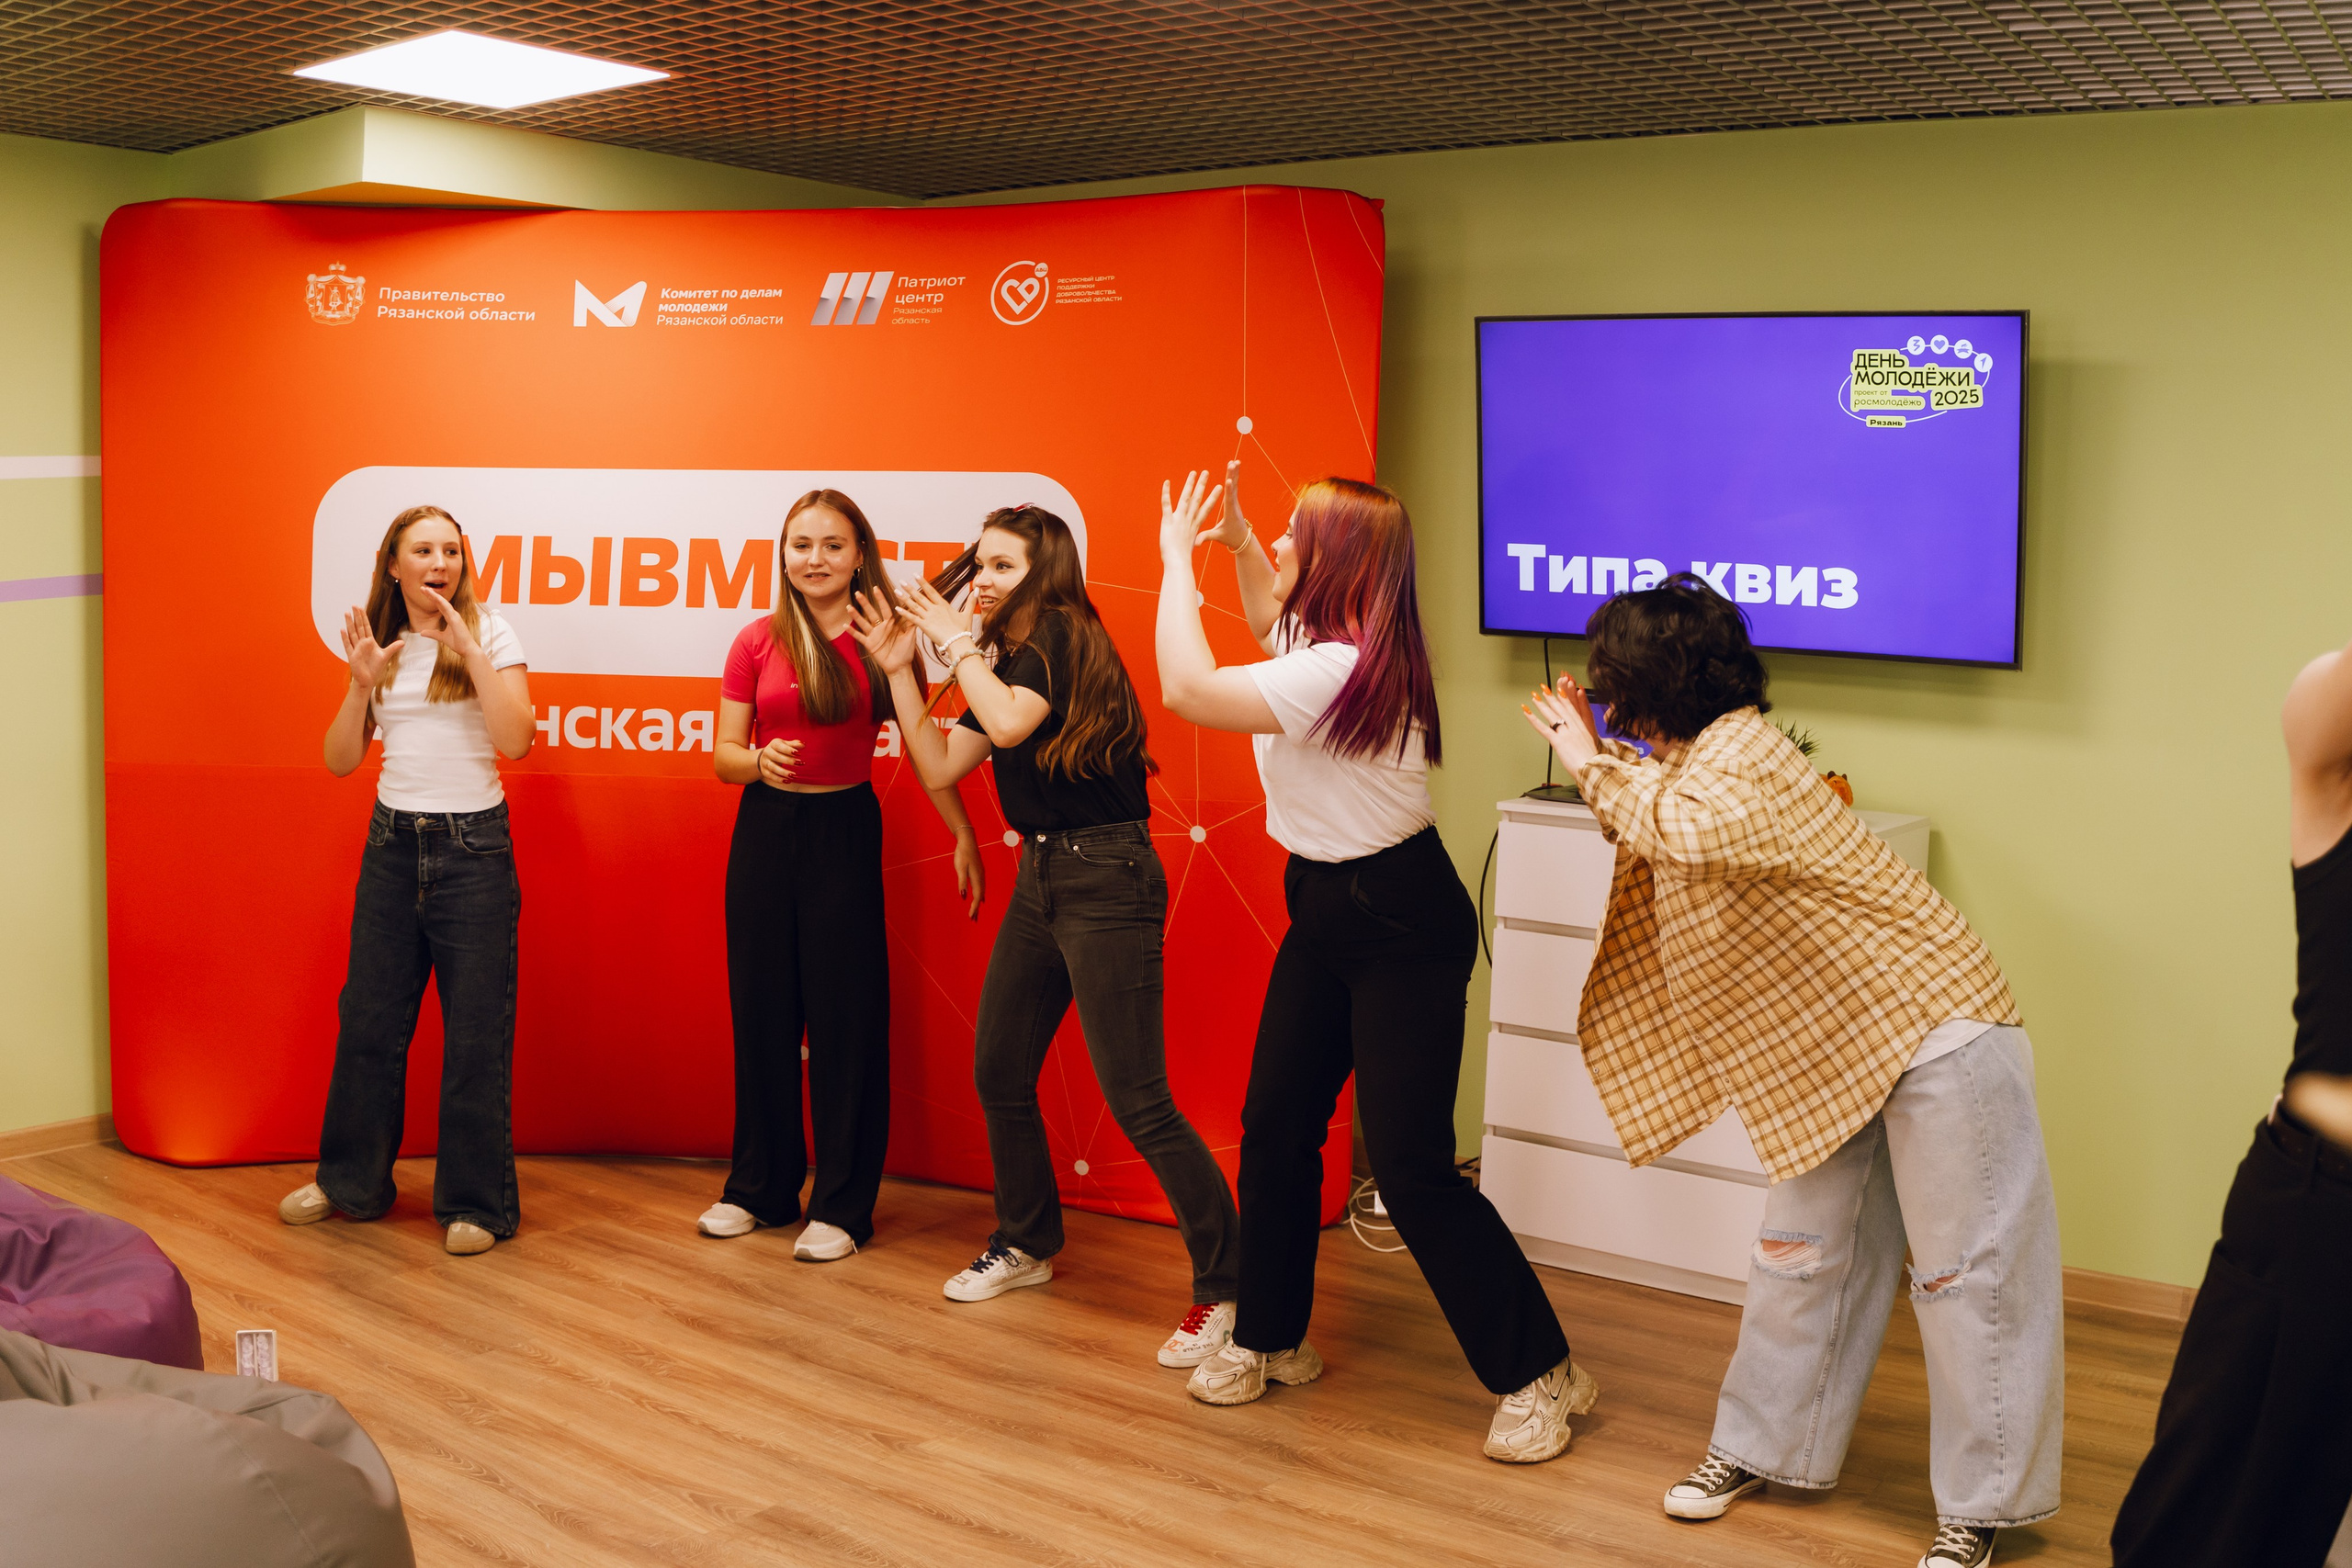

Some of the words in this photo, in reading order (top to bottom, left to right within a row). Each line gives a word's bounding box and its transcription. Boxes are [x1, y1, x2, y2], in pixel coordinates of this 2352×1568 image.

[898, 276, 967, 290] Патриот
[1057, 276, 1094, 284] РЕСУРСНЫЙ
[379, 287, 505, 302] Правительство
[661, 288, 719, 299] Комитет
[721, 289, 738, 299] по
[740, 288, 783, 299] делам
[895, 293, 944, 305] центр
[1056, 289, 1116, 298] ДОБРОВОЛЬЧЕСТВА
[377, 305, 465, 320] Рязанской
[469, 308, 536, 321] области
[658, 302, 728, 313] молодежи
[656, 314, 729, 326] Рязанской
[729, 315, 784, 326] области
[1854, 354, 1905, 370] ДЕНЬ
[1854, 367, 1970, 389] МОЛОДЁЖИ
[1854, 398, 1922, 408] росмолодёжь
[1934, 389, 1980, 406] 2025
[1870, 419, 1903, 427] Рязань
[1507, 543, 1668, 595] Типа
[1690, 560, 1860, 610] квиз
